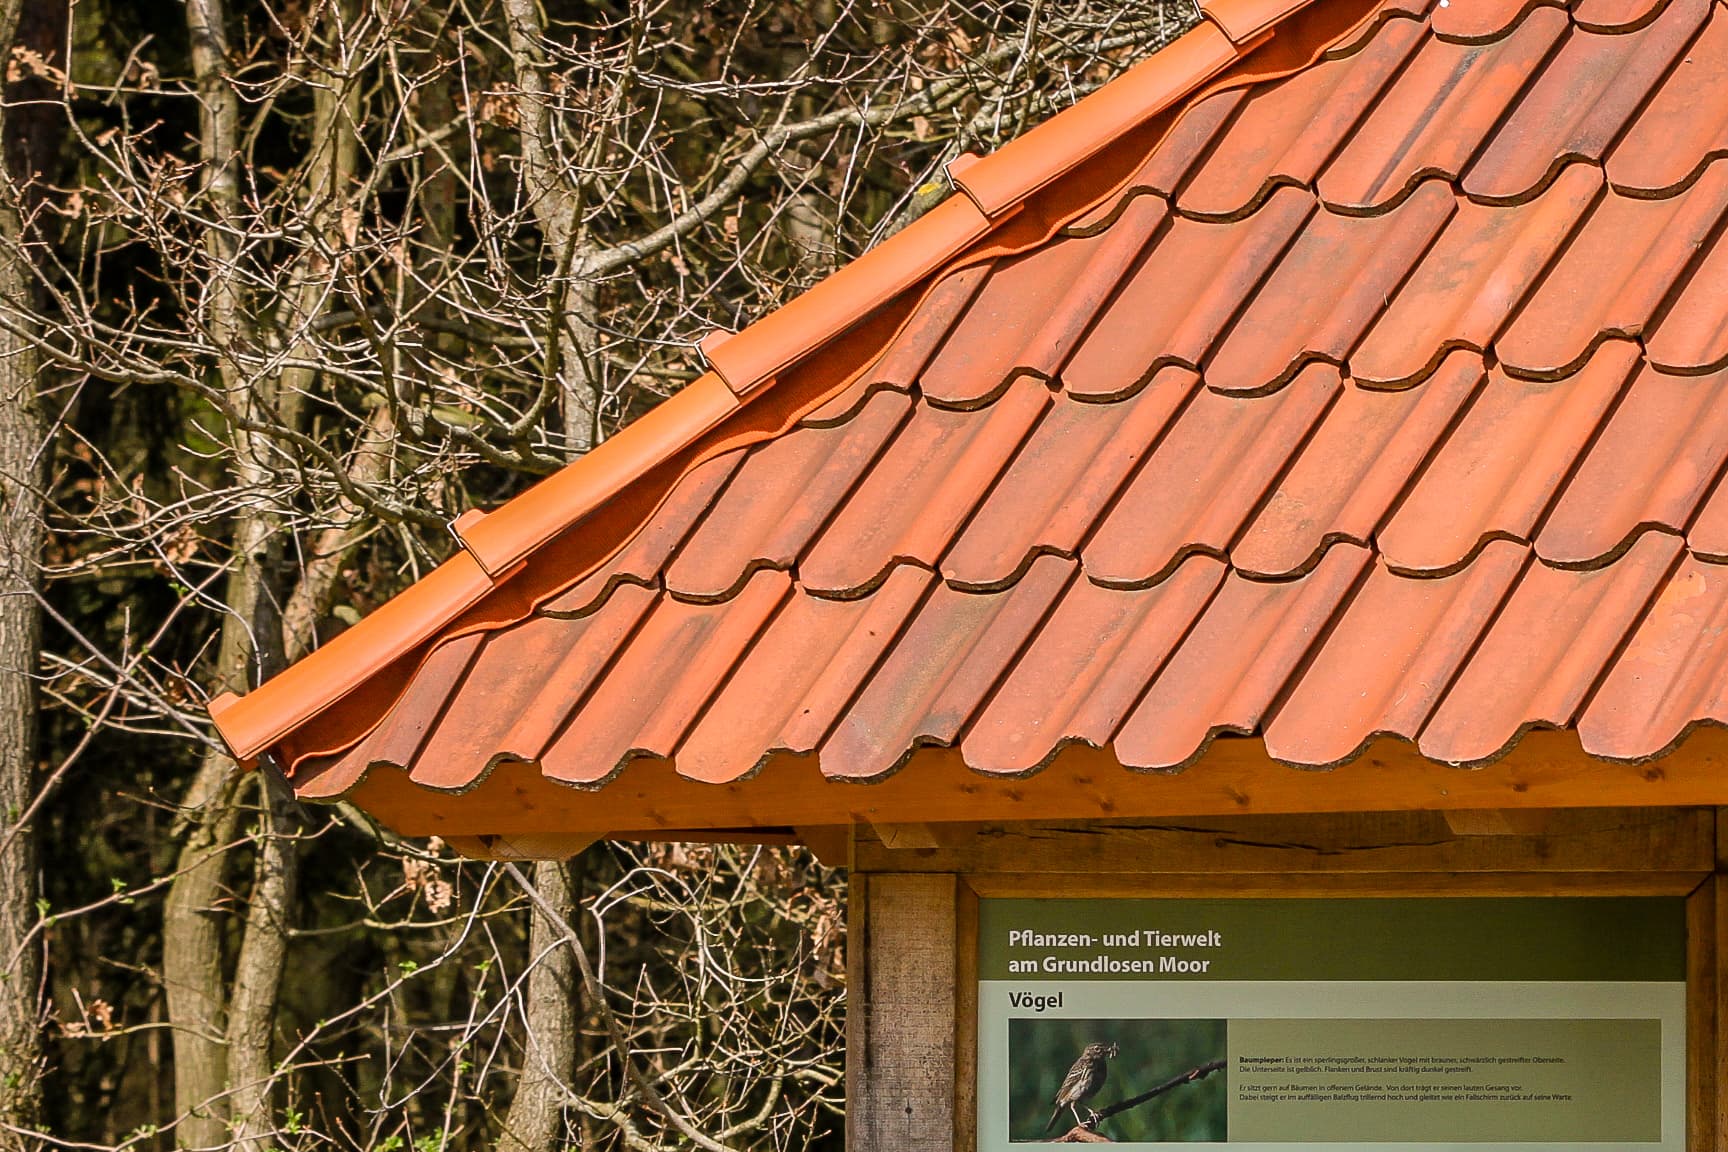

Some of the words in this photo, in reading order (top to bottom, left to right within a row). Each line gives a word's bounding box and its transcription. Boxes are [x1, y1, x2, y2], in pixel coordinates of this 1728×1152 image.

[1008, 930, 1097, 946] Pflanzen-
[1102, 930, 1139, 946] und
[1143, 930, 1222, 946] Tierwelt
[1008, 961, 1037, 973] am
[1042, 957, 1153, 973] Grundlosen
[1159, 958, 1210, 973] Moor
[1008, 991, 1064, 1013] Vögel
